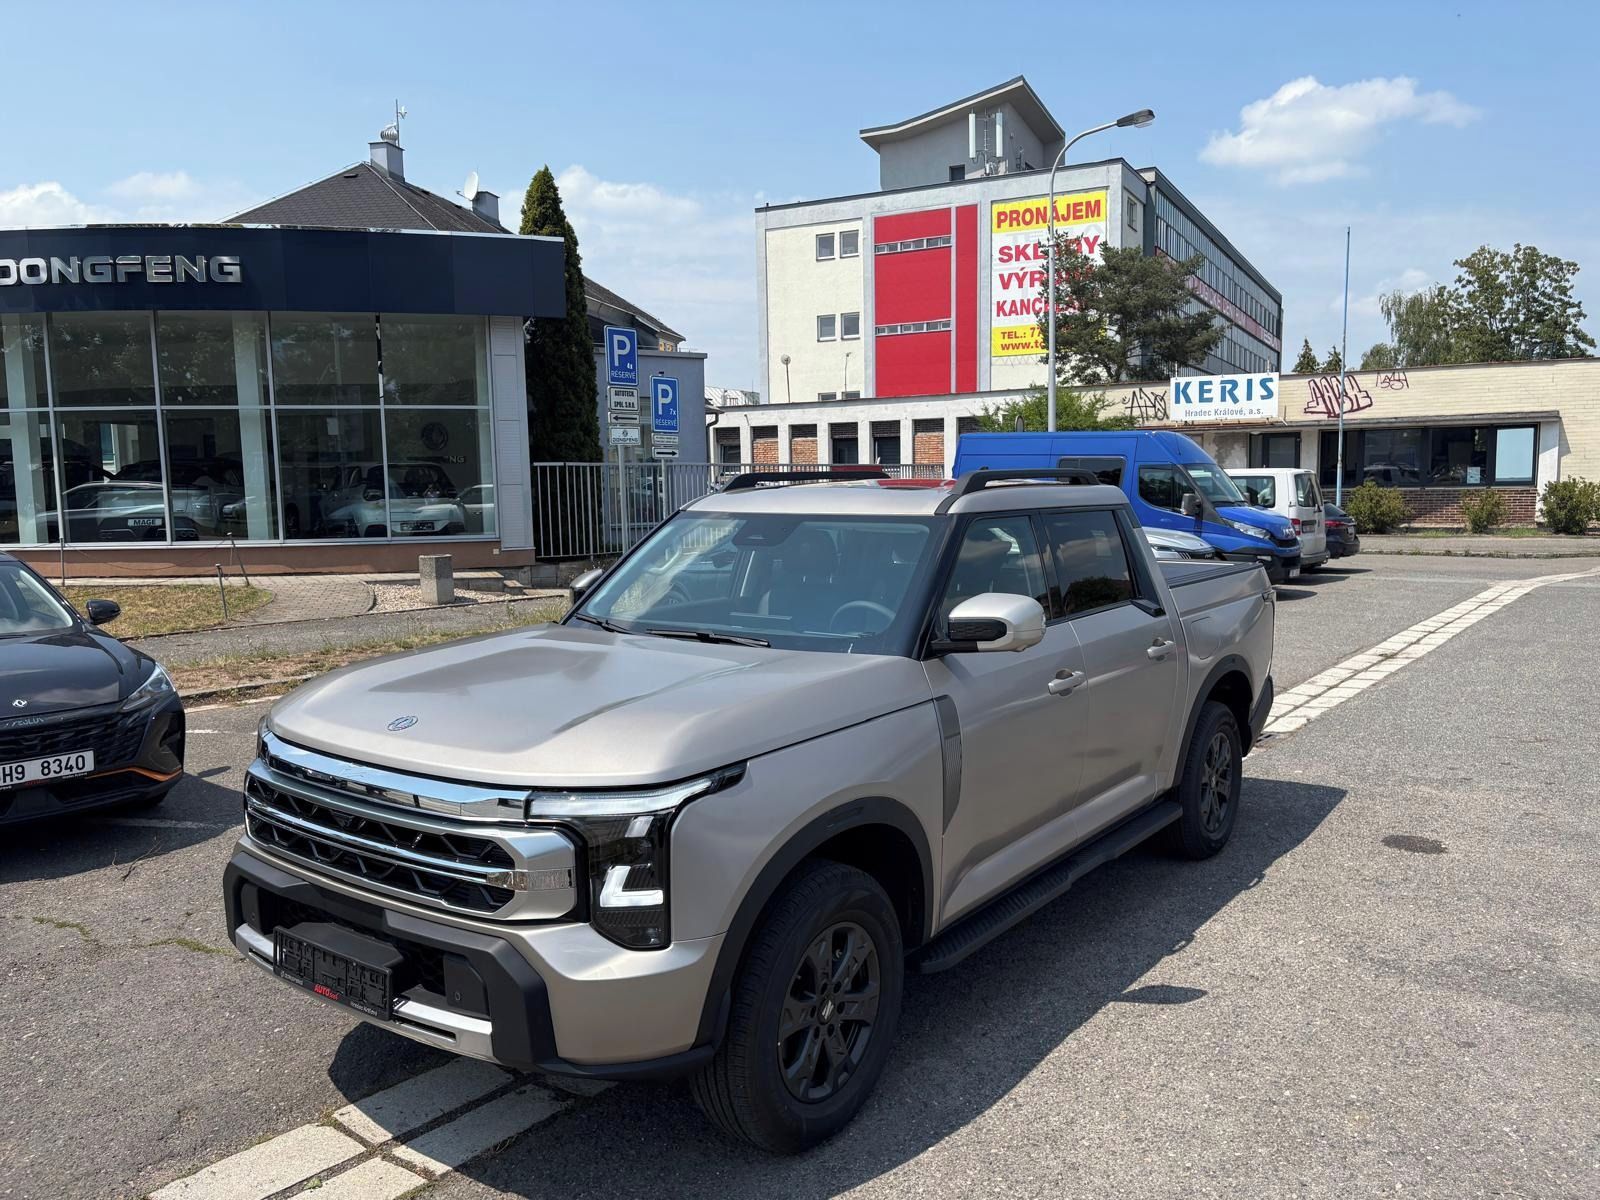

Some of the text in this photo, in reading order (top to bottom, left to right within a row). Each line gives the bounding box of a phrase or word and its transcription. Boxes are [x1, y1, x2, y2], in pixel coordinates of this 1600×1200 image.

[996, 199, 1101, 229] PRONÁJEM
[998, 235, 1100, 263] SKLY
[1001, 331, 1026, 340] TEL.:
[612, 334, 631, 366] P
[657, 383, 673, 415] P
[1174, 377, 1274, 405] KERIS
[669, 408, 677, 416] 7x
[1185, 409, 1211, 417] Hradec
[0, 765, 25, 783] H9
[40, 754, 86, 777] 8340
